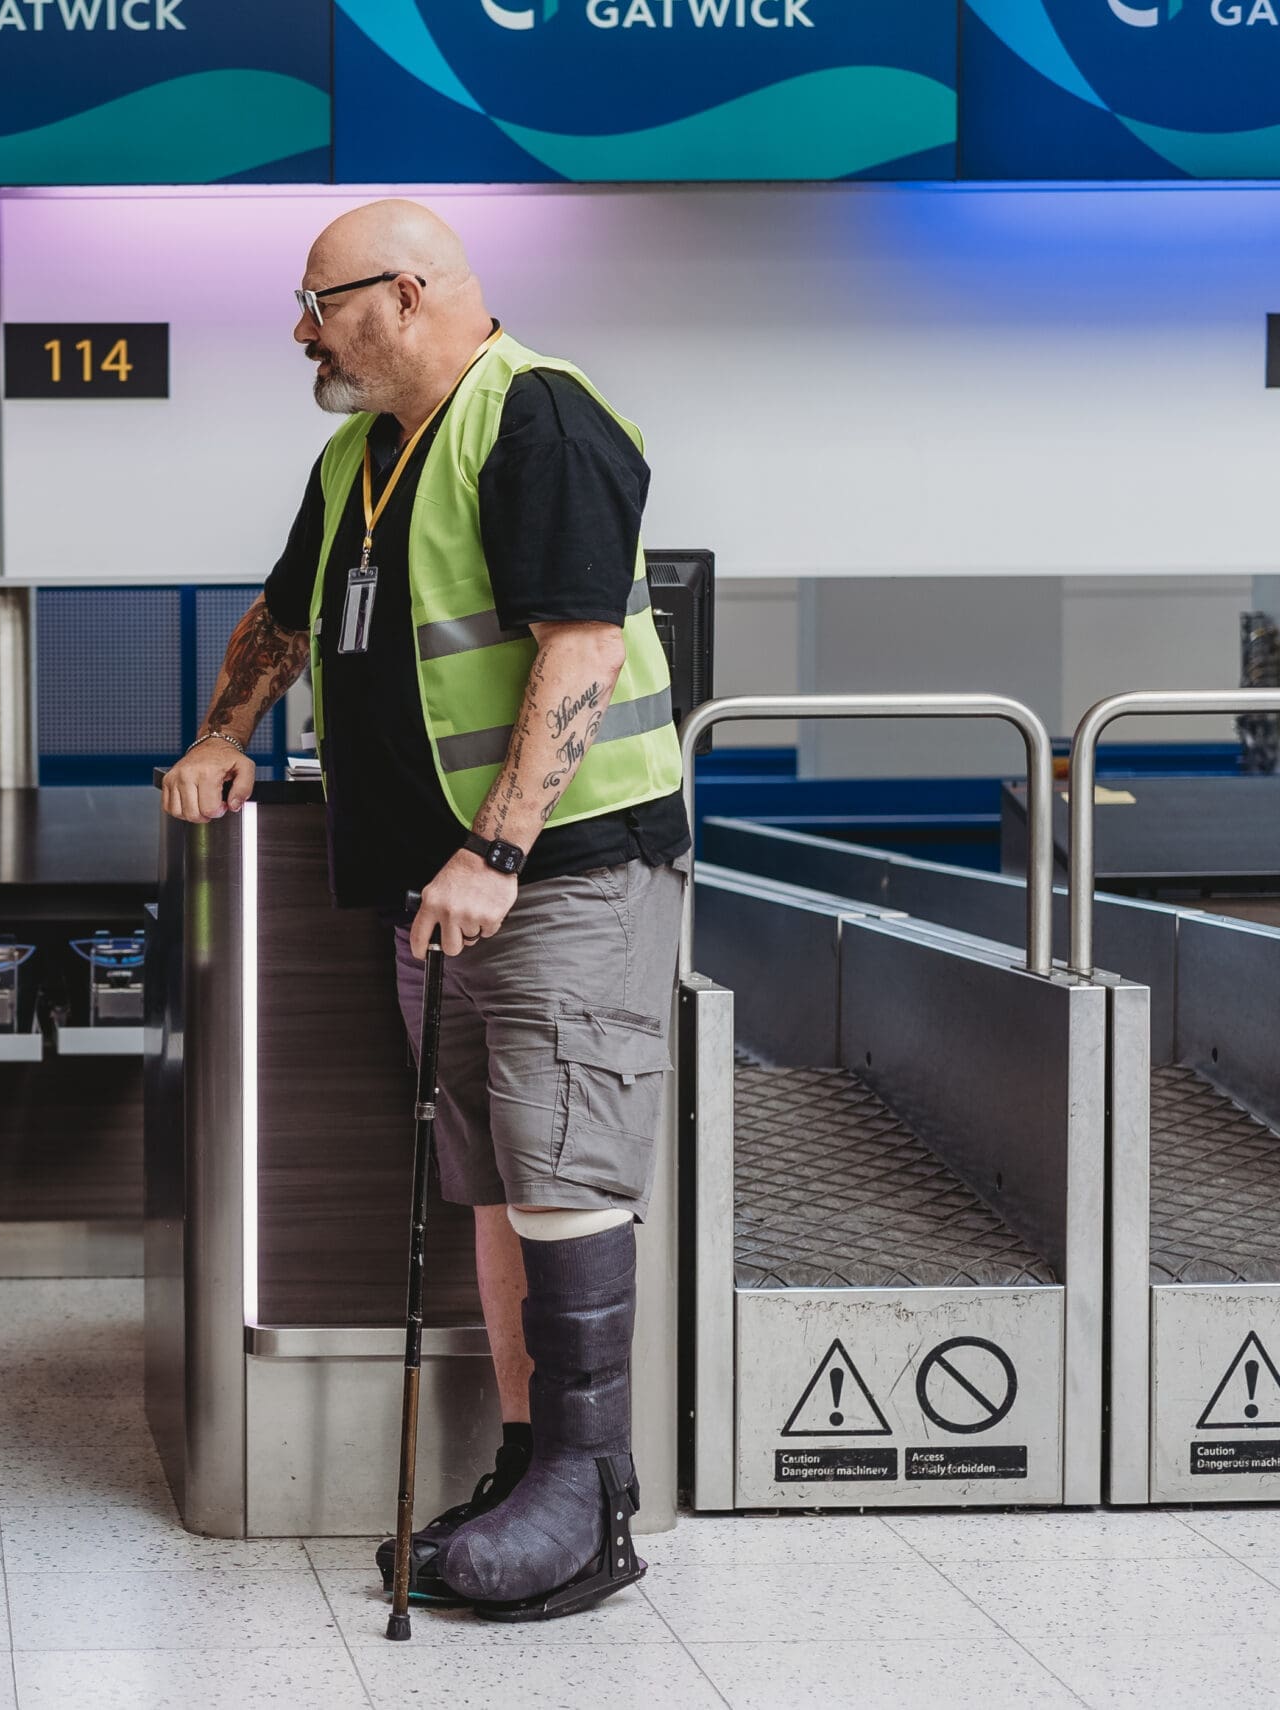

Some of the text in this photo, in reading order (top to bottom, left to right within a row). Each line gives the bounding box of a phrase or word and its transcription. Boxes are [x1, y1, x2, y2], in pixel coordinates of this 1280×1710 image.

[585, 0, 815, 28] GATWICK
[44, 339, 133, 383] 114
[546, 681, 602, 740] Honour
[1197, 1446, 1235, 1456] Caution
[782, 1454, 820, 1464] Caution
[912, 1452, 945, 1462] Access
[947, 1463, 996, 1474] forbidden
[1197, 1459, 1249, 1470] Dangerous
[782, 1465, 888, 1478] Dangerous machinery
